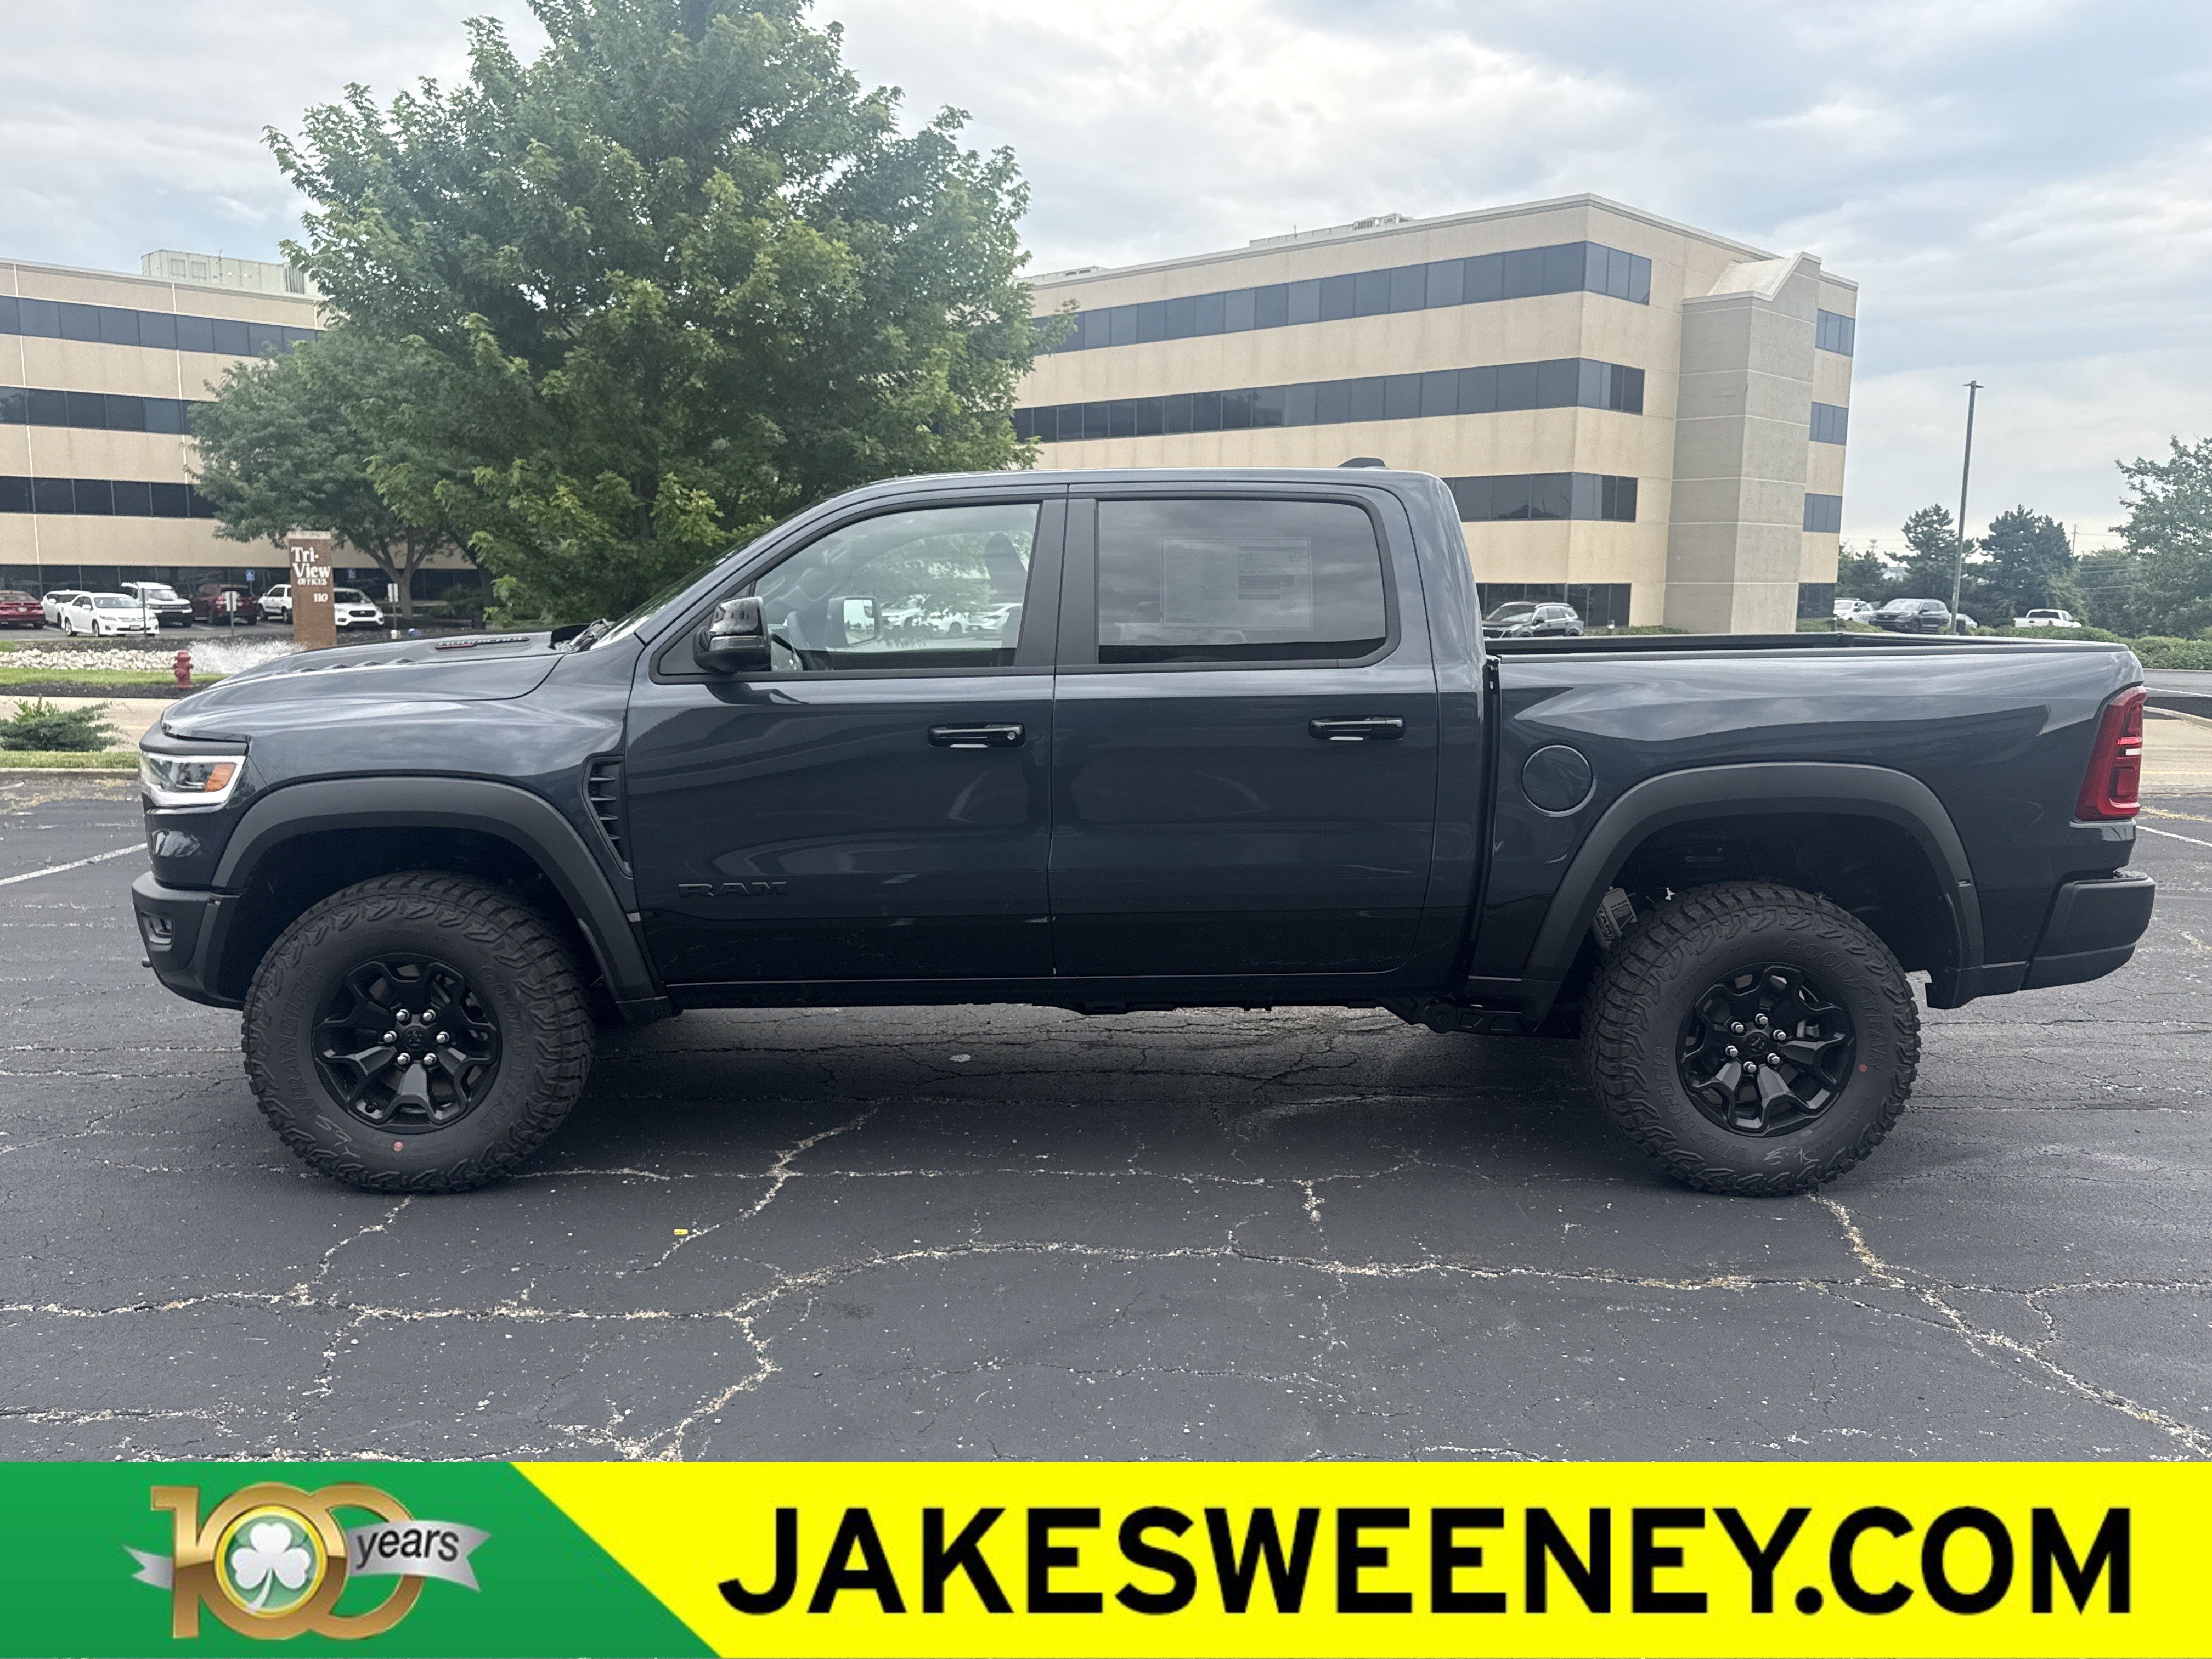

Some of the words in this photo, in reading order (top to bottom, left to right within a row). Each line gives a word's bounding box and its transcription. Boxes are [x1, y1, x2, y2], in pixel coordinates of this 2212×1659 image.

[292, 563, 331, 578] View
[313, 593, 328, 602] 110
[678, 882, 787, 896] RAM
[1782, 938, 1888, 1070] GOODYEAR
